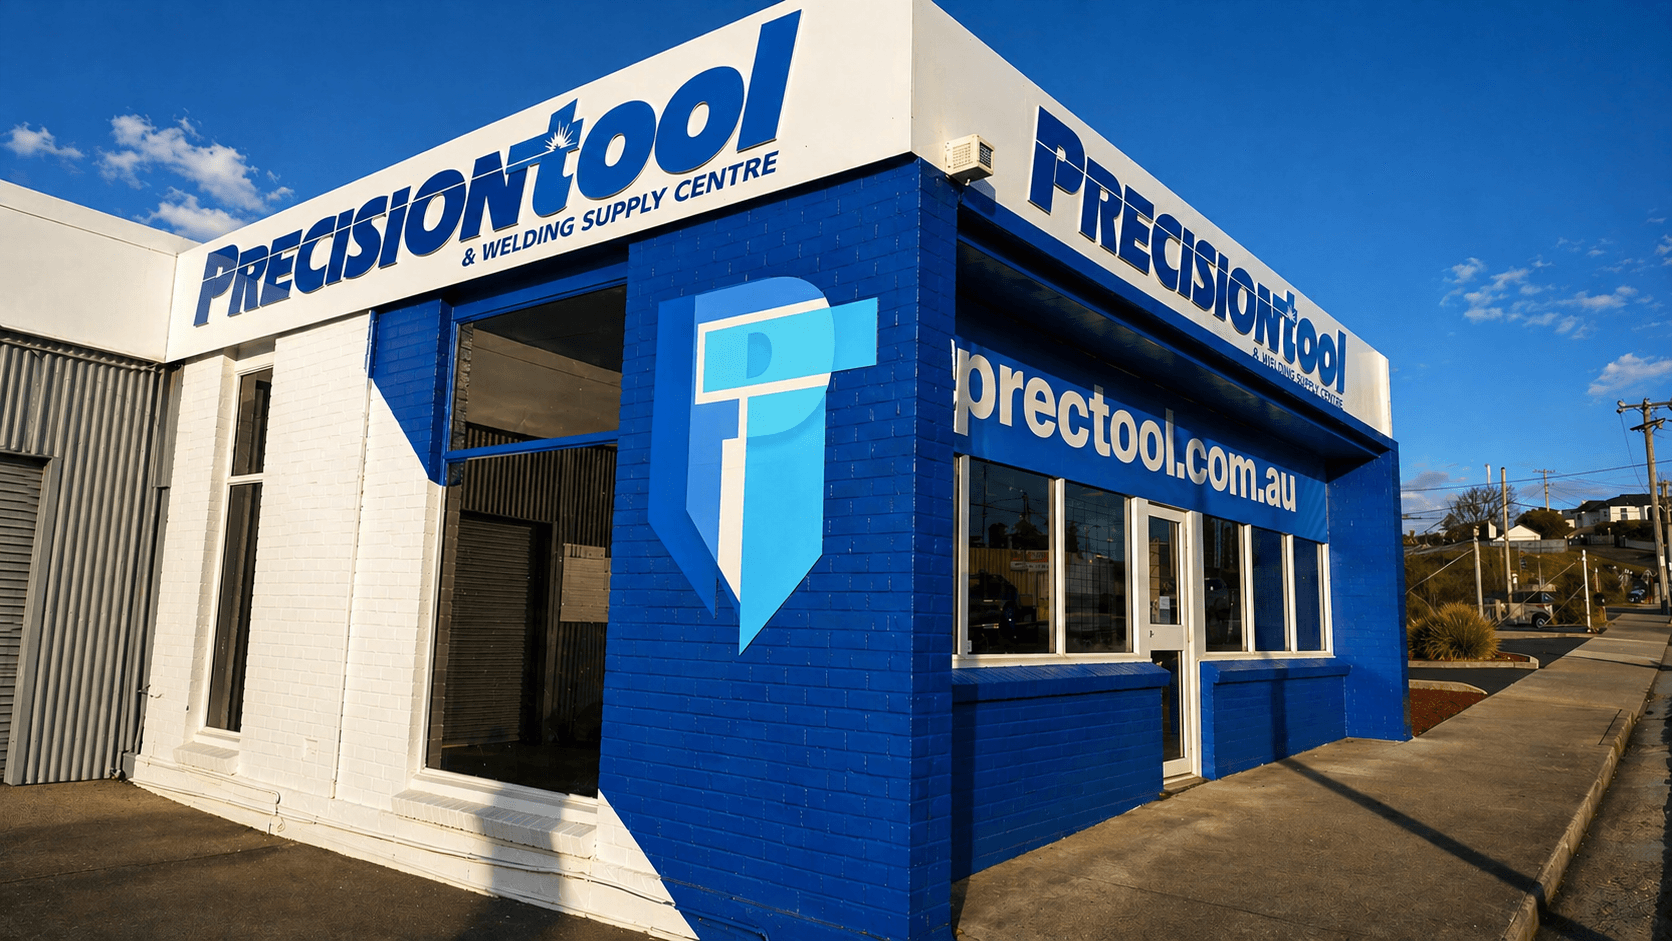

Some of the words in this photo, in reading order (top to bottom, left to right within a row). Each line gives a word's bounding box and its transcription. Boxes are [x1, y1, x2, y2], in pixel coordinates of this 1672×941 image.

[461, 248, 475, 267] &
[482, 217, 574, 260] WELDING
[581, 187, 668, 231] SUPPLY
[674, 150, 779, 202] CENTRE
[1252, 347, 1259, 360] &
[1262, 352, 1295, 381] WELDING
[953, 347, 1297, 513] prectool.com.au
